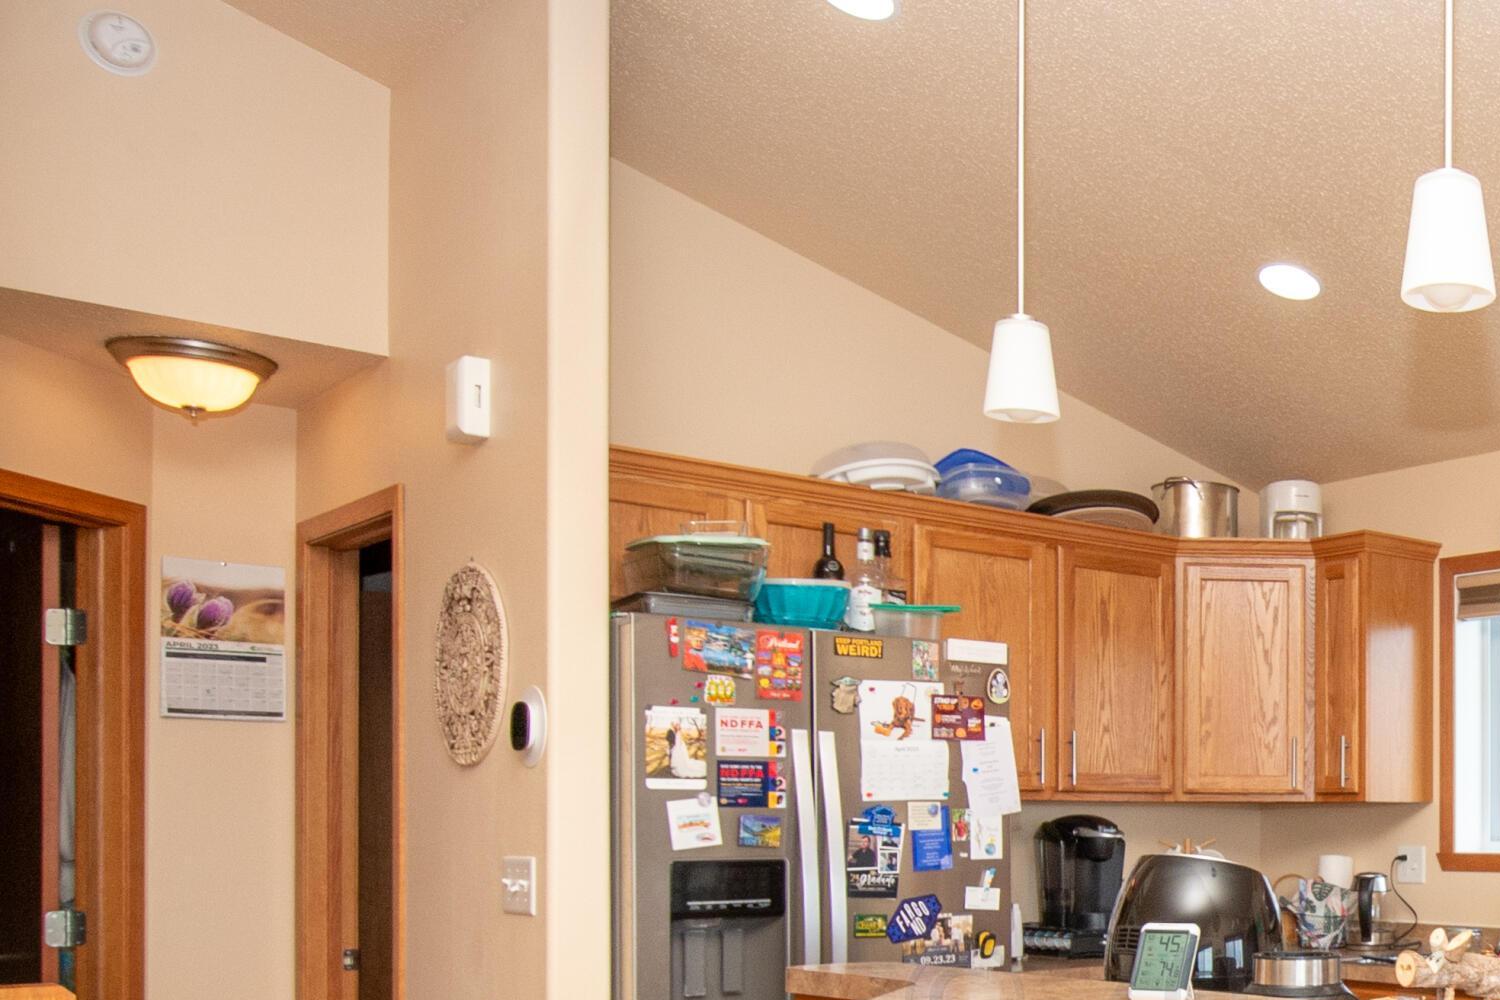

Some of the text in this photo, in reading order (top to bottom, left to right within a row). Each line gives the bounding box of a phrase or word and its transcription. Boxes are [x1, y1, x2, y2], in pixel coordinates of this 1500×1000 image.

[166, 641, 194, 649] APRIL
[837, 643, 882, 658] WEIRD!
[720, 720, 763, 729] ND FFA
[896, 900, 930, 933] FARGO
[910, 916, 927, 936] ND
[1159, 935, 1181, 953] 45
[920, 954, 956, 965] 09.23.23
